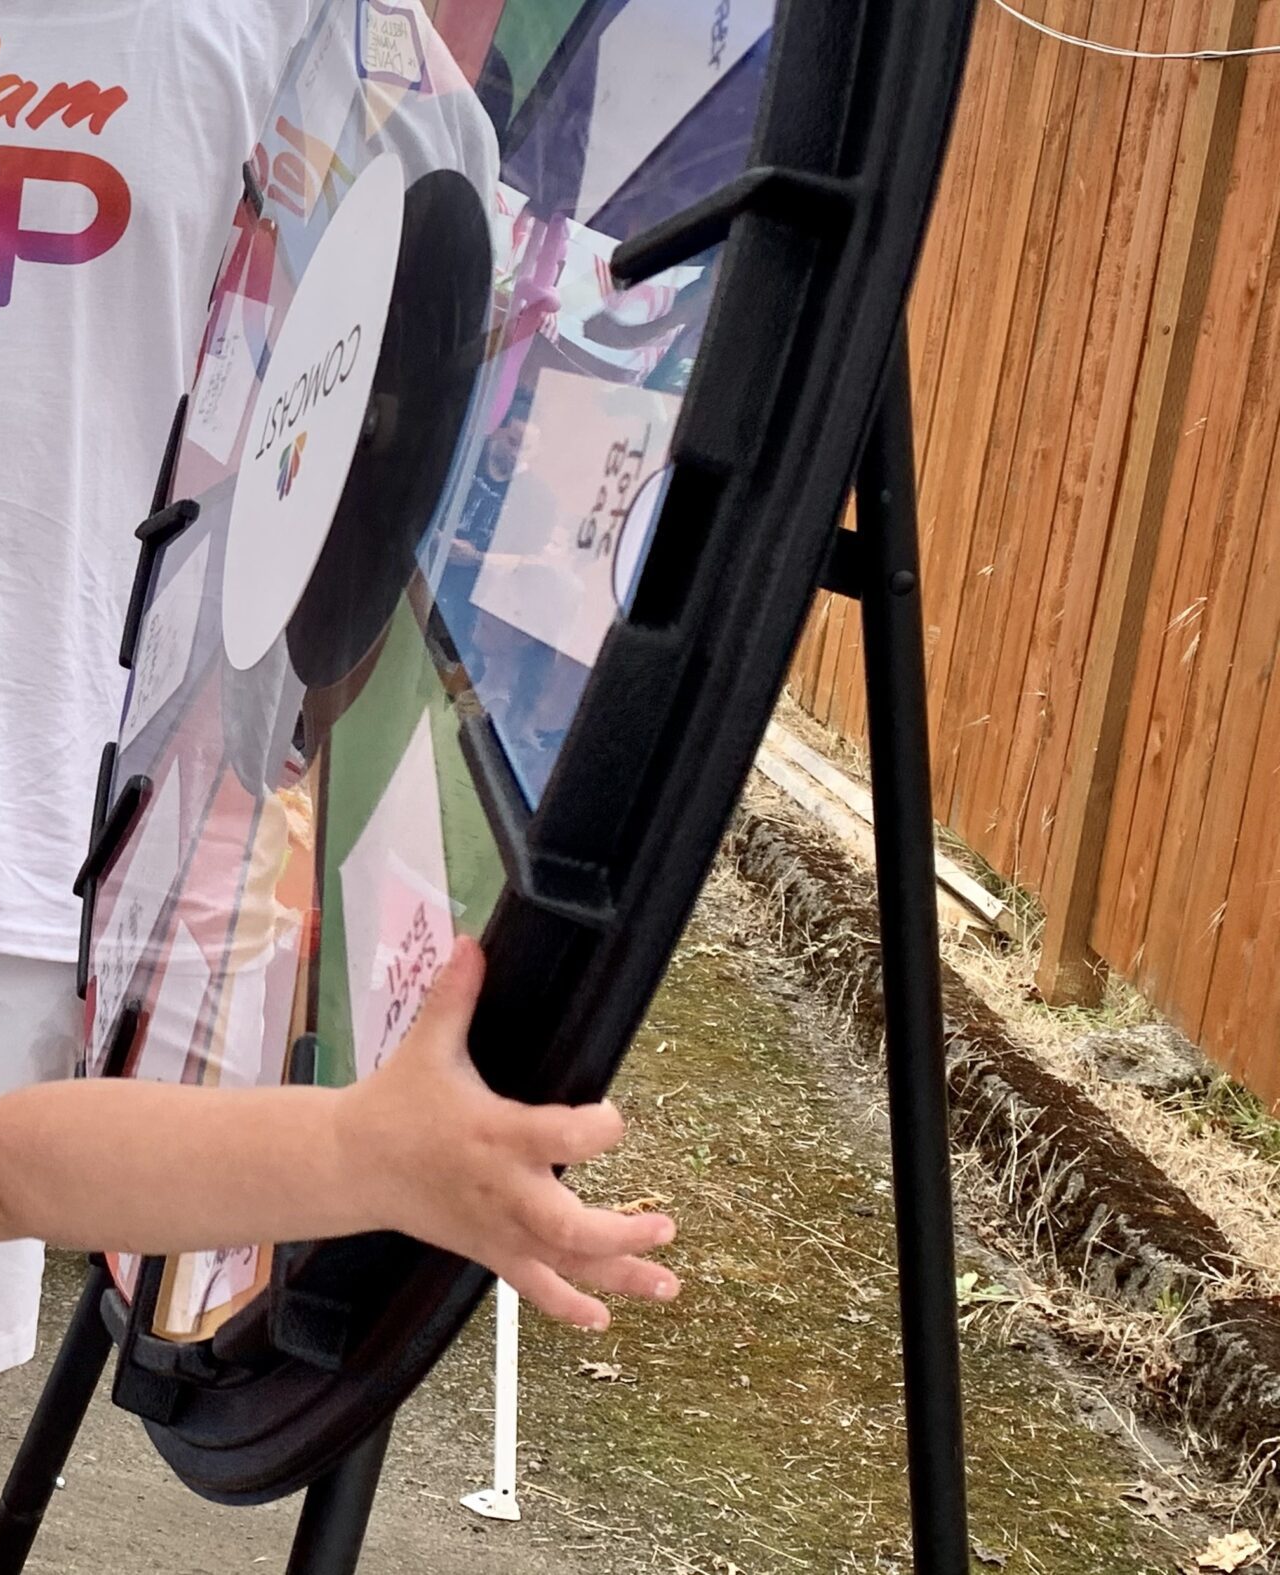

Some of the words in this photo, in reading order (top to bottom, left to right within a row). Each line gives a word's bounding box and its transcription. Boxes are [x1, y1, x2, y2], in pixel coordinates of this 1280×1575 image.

[255, 323, 361, 461] COMCAST
[577, 437, 628, 549] Bag
[596, 421, 651, 560] Tote
